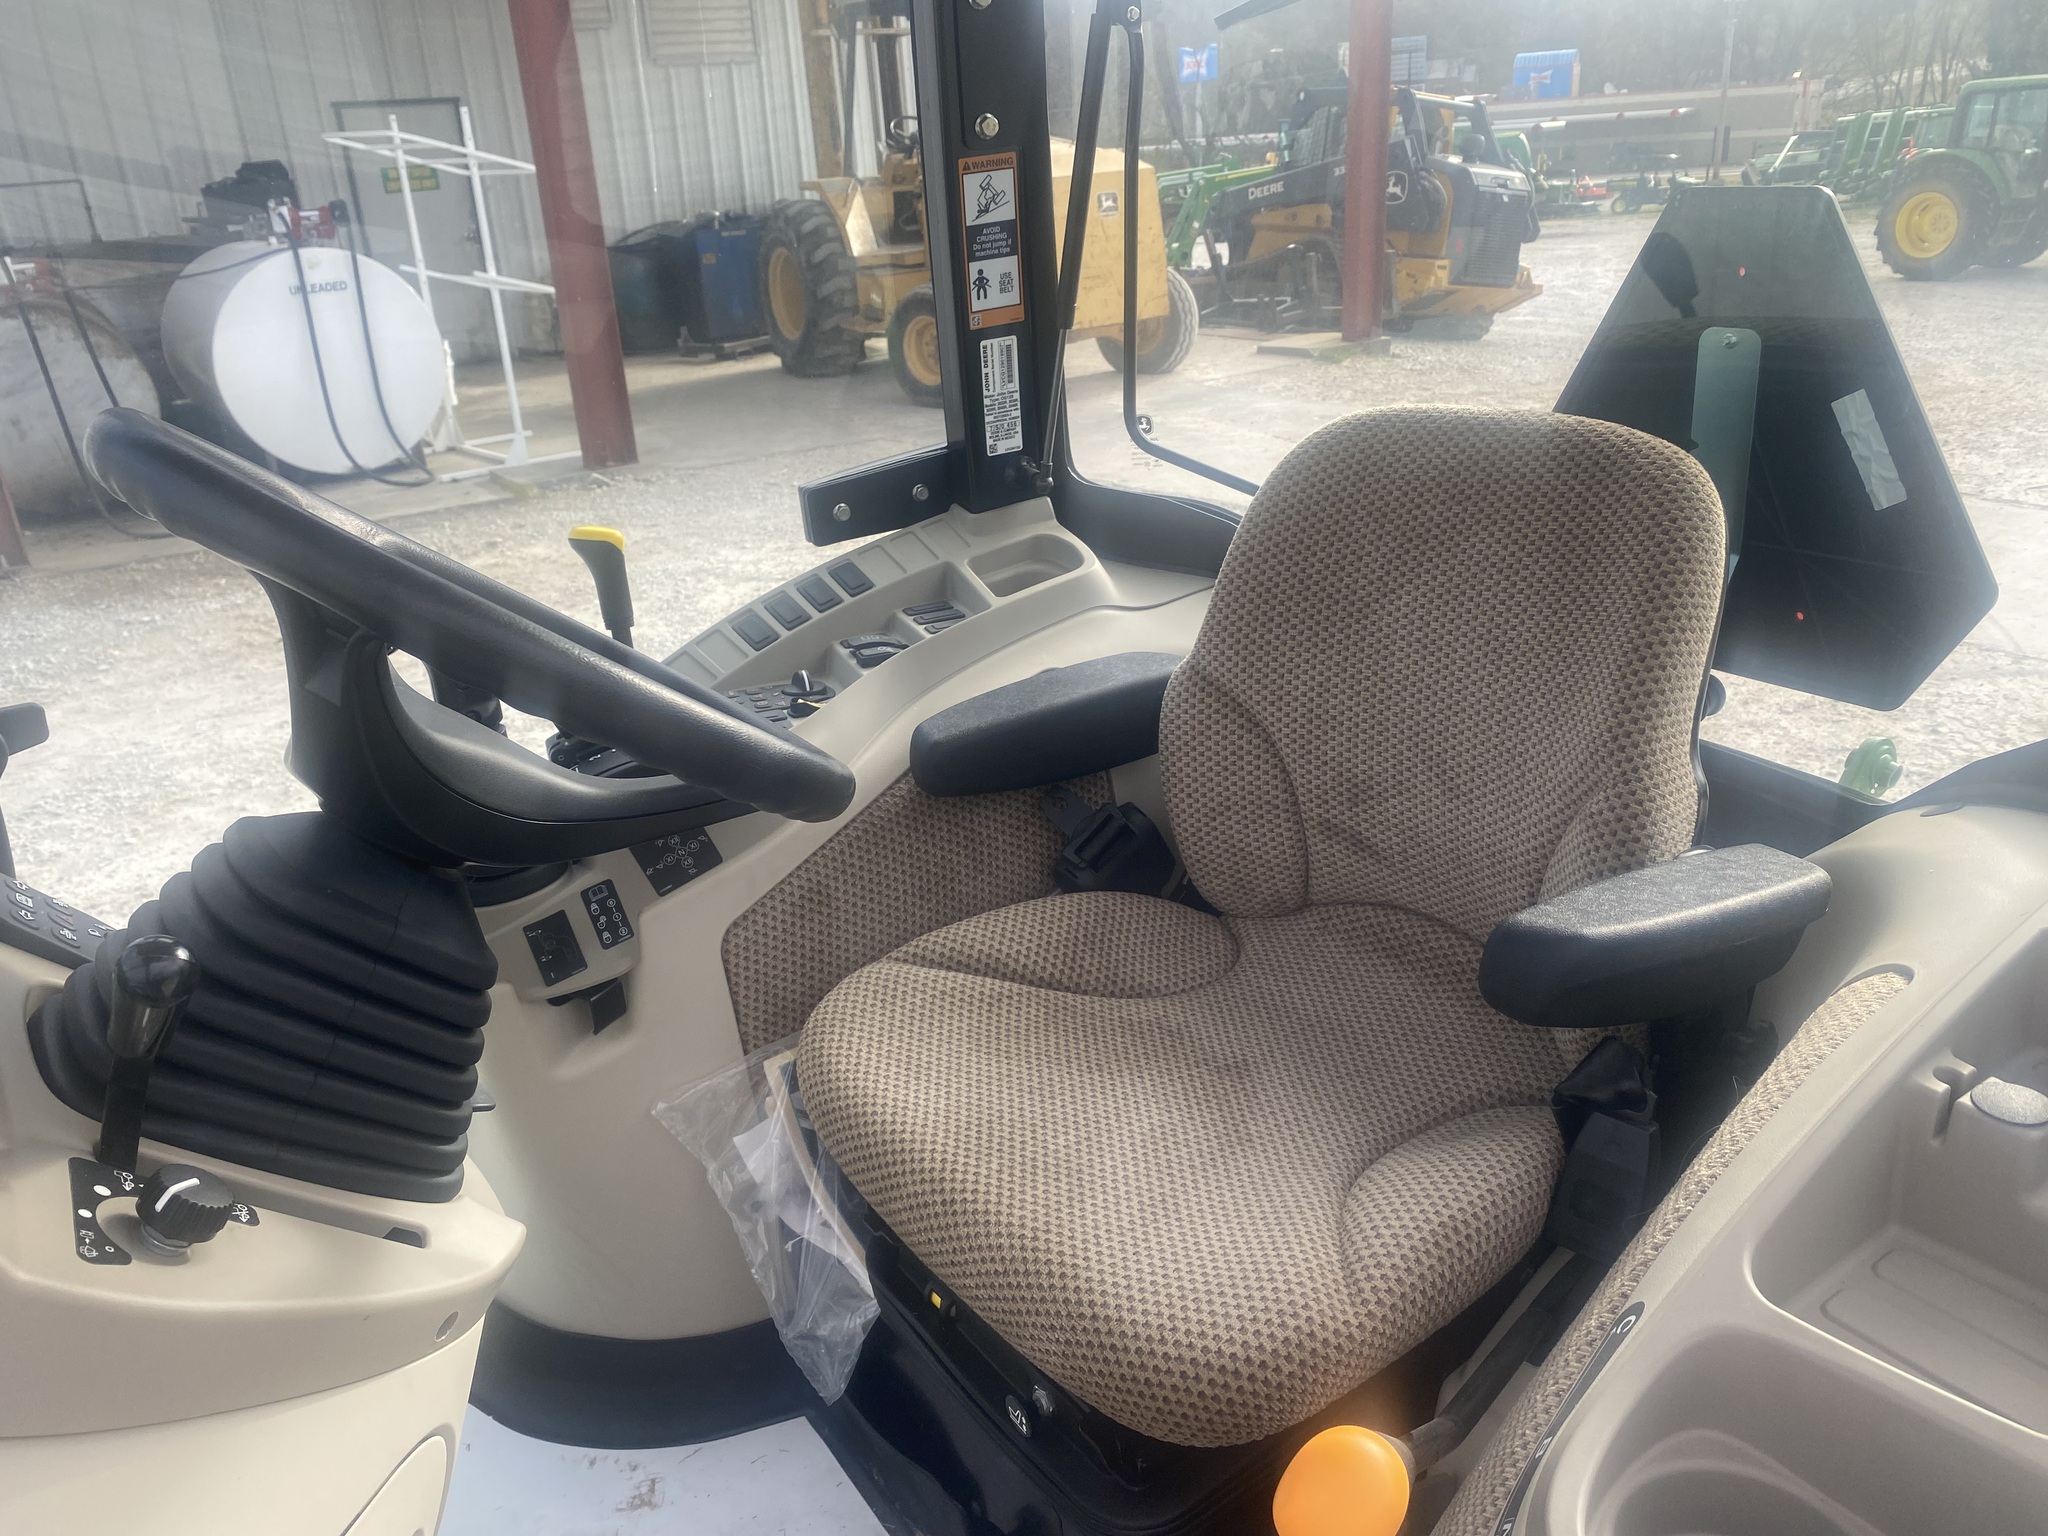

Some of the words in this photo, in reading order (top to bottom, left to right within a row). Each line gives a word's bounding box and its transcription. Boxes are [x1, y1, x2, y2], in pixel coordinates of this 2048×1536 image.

[971, 156, 1014, 170] WARNING
[1248, 181, 1284, 200] DEERE
[982, 226, 1001, 235] AVOID
[976, 232, 1008, 243] CRUSHING
[992, 240, 1007, 248] jump
[975, 249, 998, 257] machine
[999, 271, 1013, 280] USE
[288, 280, 348, 296] UNEADED
[998, 278, 1014, 288] SEAT
[999, 285, 1014, 295] BELT
[983, 372, 991, 393] JOHN
